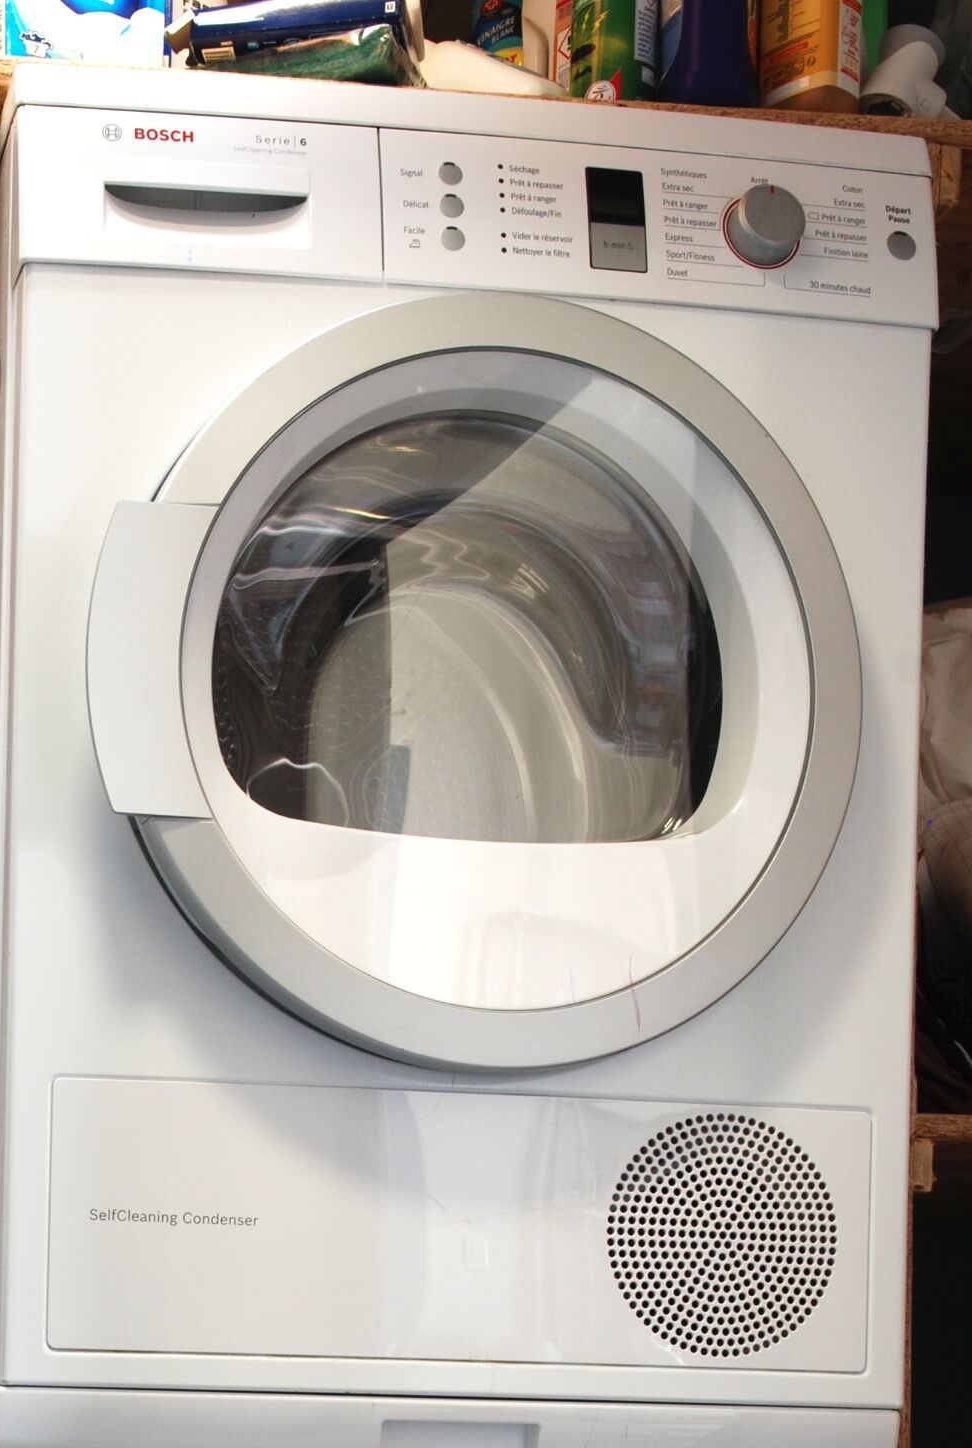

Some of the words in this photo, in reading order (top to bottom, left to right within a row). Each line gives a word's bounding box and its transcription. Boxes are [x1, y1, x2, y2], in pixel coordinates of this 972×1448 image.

[477, 16, 515, 46] VINAIGRE
[134, 128, 194, 143] BOSCH
[255, 134, 291, 146] Serie
[300, 138, 307, 147] 6
[400, 168, 423, 178] Signal
[509, 165, 540, 174] Séchage
[661, 168, 707, 179] Synthétiques
[510, 179, 525, 187] Prêt
[533, 182, 563, 190] repasser
[662, 183, 680, 191] Extra
[842, 185, 863, 194] Coton
[511, 192, 526, 201] Prêt
[533, 196, 556, 204] ranger
[834, 199, 851, 207] Extra
[403, 200, 429, 208] Délicat
[663, 199, 678, 208] Prêt
[685, 202, 708, 210] ranger
[511, 207, 562, 218] Défoulage/Fin
[886, 205, 911, 215] Départ
[664, 216, 679, 224] Prêt
[686, 218, 717, 227] repasser
[822, 212, 836, 221] Prêt
[844, 216, 866, 225] ranger
[888, 215, 910, 224] Pause
[404, 226, 425, 234] Facile
[815, 229, 829, 237] Prêt
[837, 232, 867, 241] repasser
[512, 232, 531, 241] Vider
[541, 234, 573, 243] réservoir
[665, 233, 693, 243] Express
[513, 247, 543, 257] Nettoyer
[553, 250, 570, 258] filtre
[666, 250, 715, 262] Sport/Fitness
[824, 247, 850, 256] Finition
[852, 250, 868, 258] laine
[667, 268, 688, 277] Duvet
[820, 283, 848, 292] minutes
[850, 285, 871, 294] chaud
[89, 1208, 178, 1226] SelfCleaning
[182, 1212, 259, 1226] Condenser
